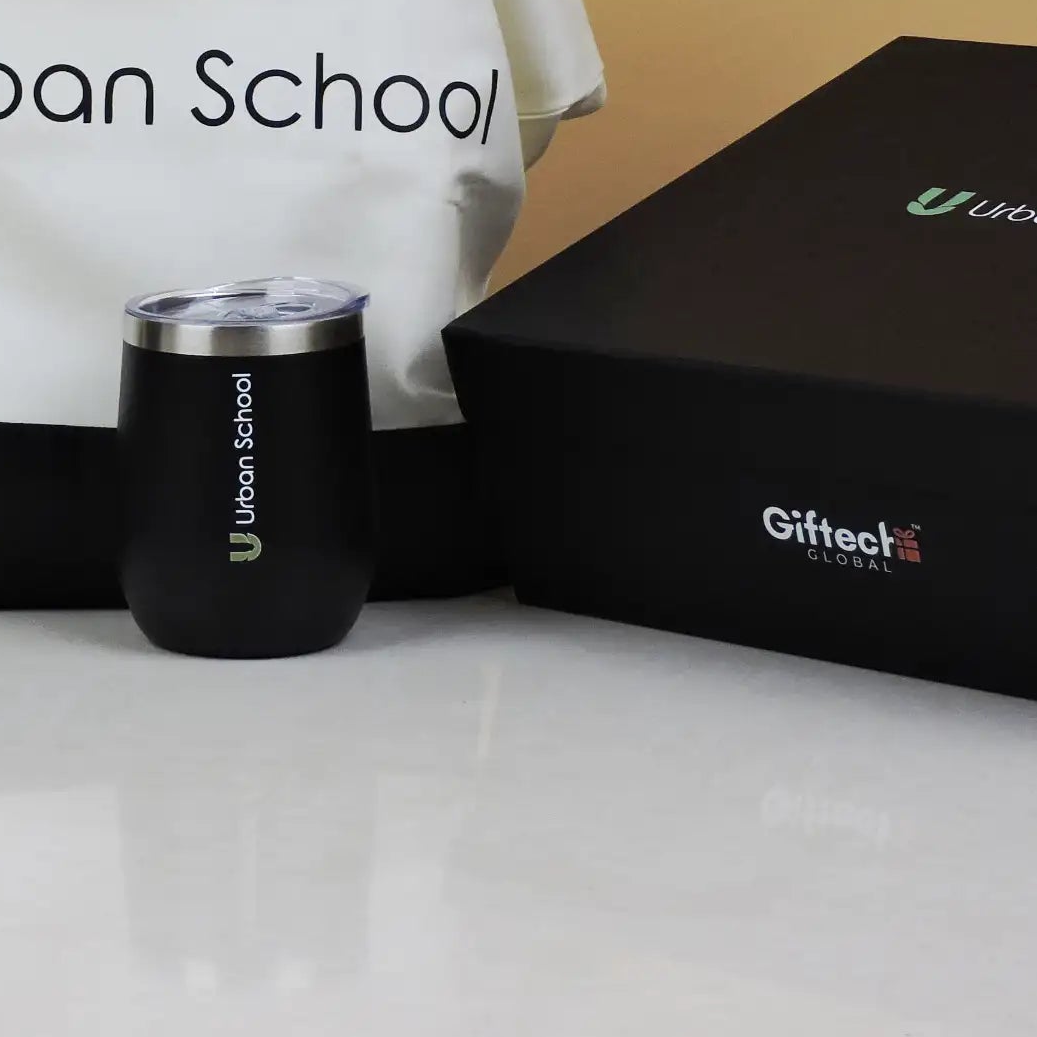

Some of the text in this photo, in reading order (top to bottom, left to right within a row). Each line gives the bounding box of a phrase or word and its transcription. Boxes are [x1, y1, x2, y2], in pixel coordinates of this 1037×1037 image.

[191, 50, 498, 144] School
[968, 199, 1037, 224] Urb
[231, 373, 254, 450] School
[234, 456, 255, 525] Urban
[807, 548, 892, 573] GLOBAL
